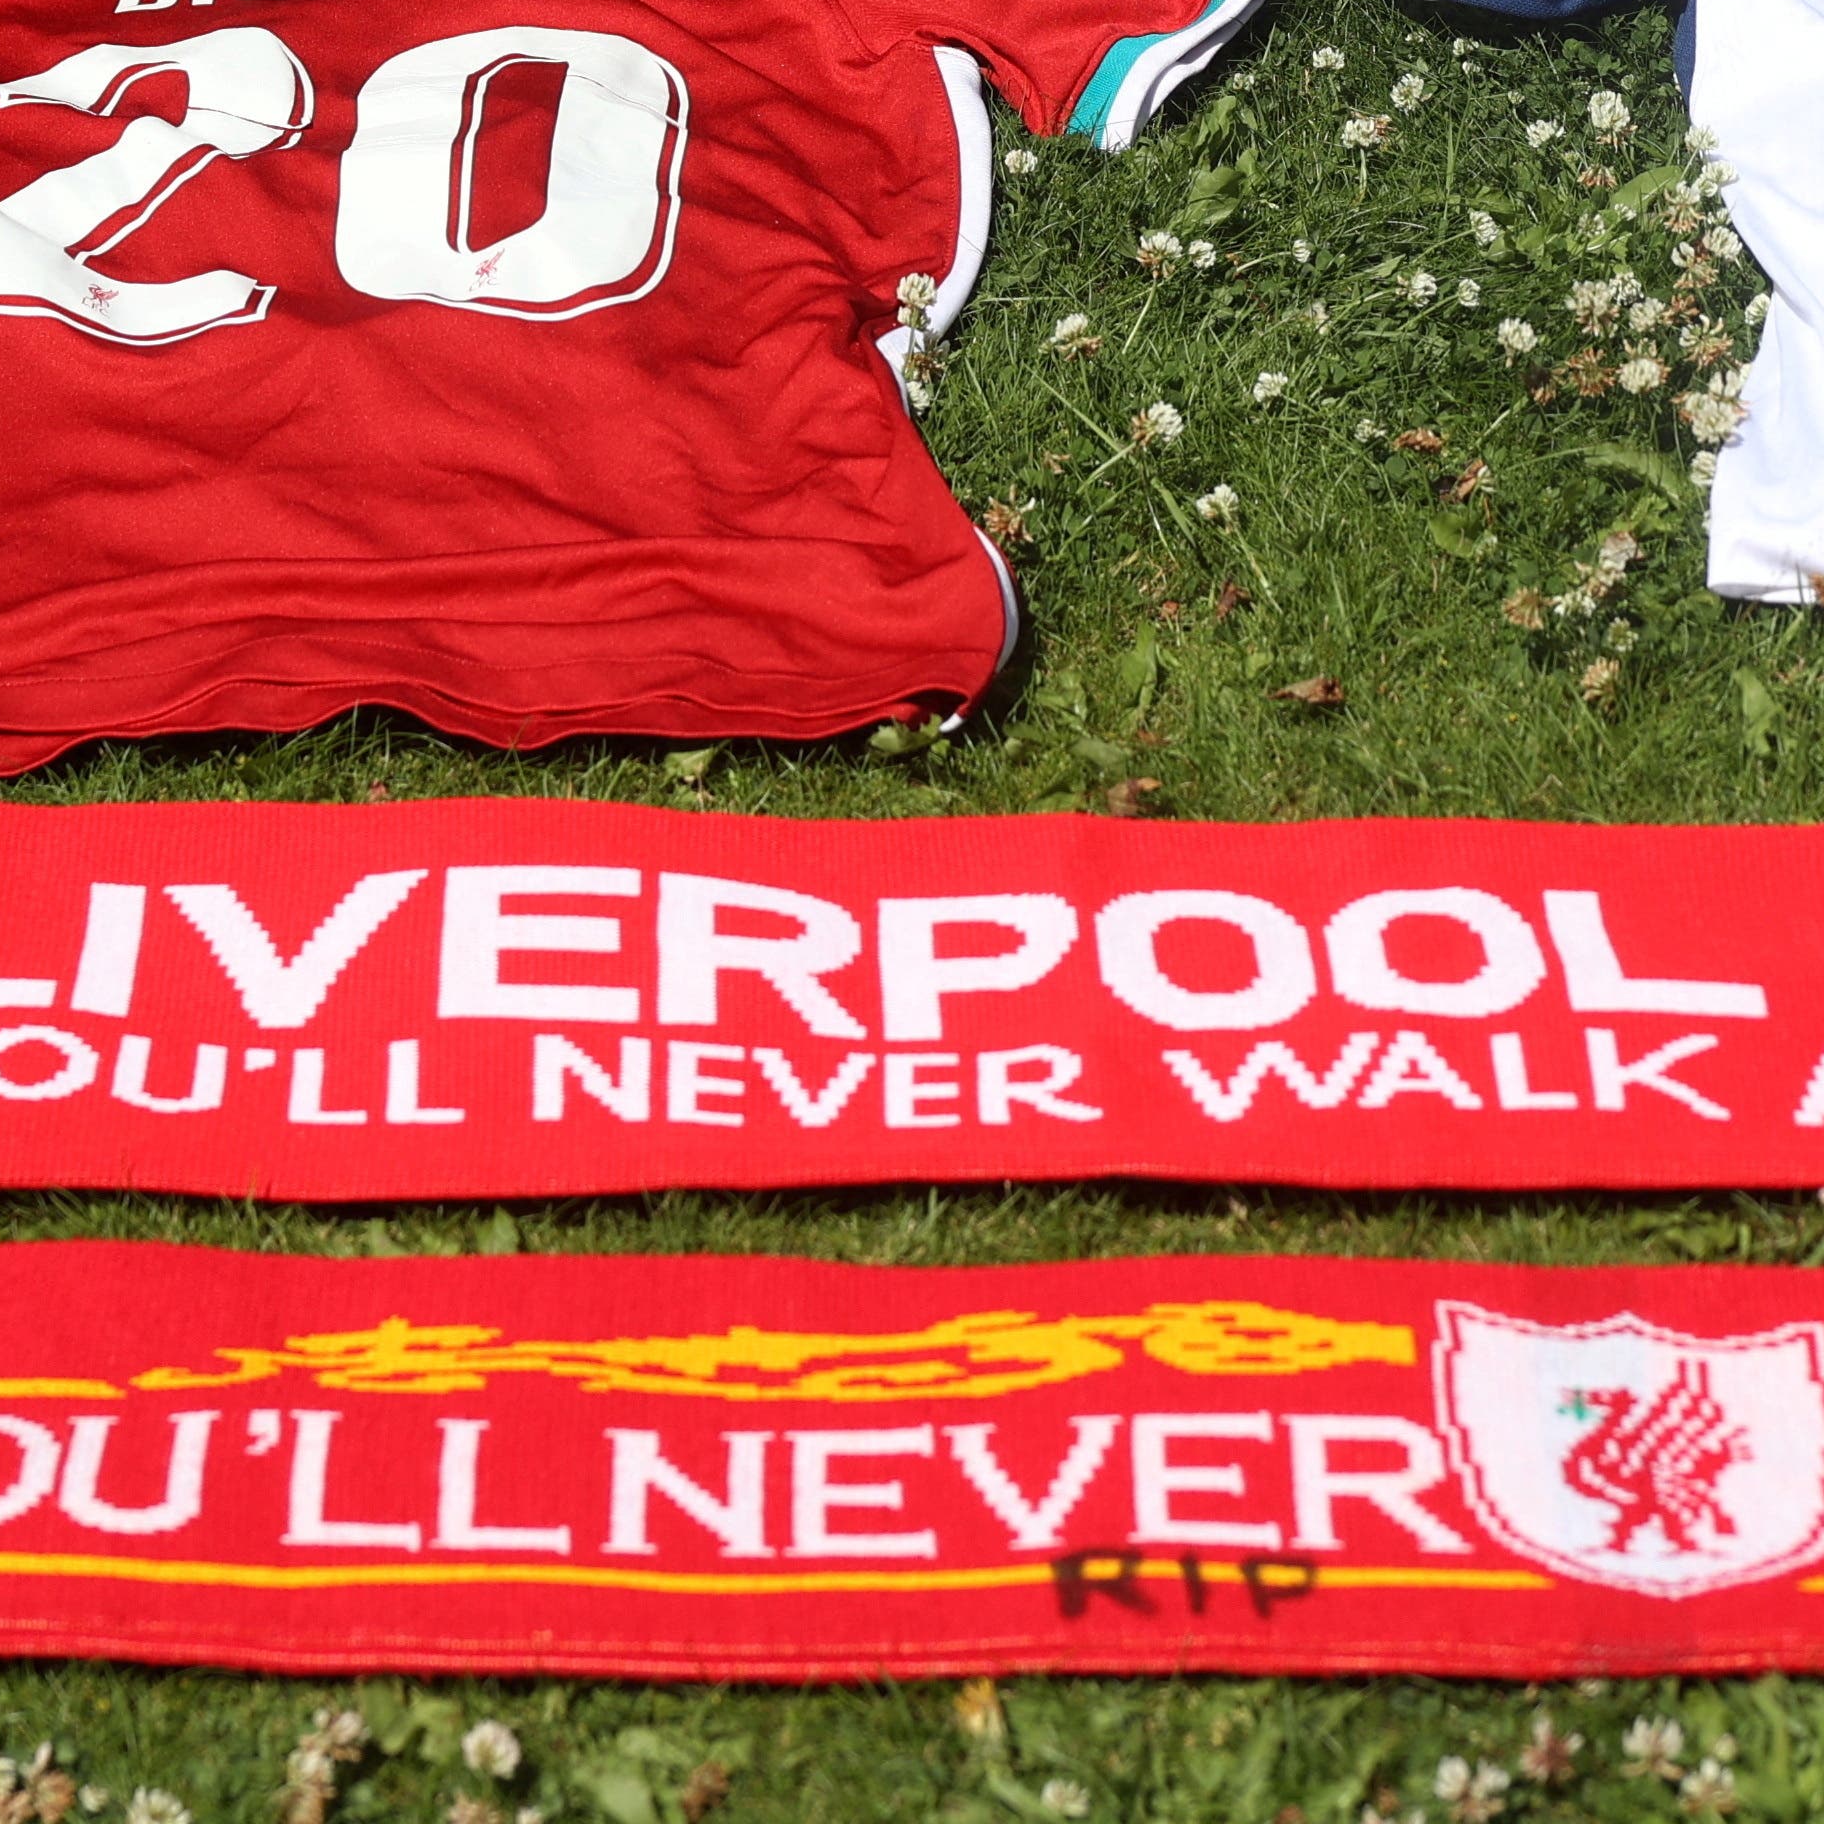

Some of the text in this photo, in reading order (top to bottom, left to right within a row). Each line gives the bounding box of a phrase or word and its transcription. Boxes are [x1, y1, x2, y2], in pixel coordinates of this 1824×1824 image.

[533, 1034, 1103, 1128] NEVER
[1162, 1027, 1730, 1122] WALK
[605, 1411, 1473, 1558] NEVER
[1051, 1546, 1320, 1618] RIP
